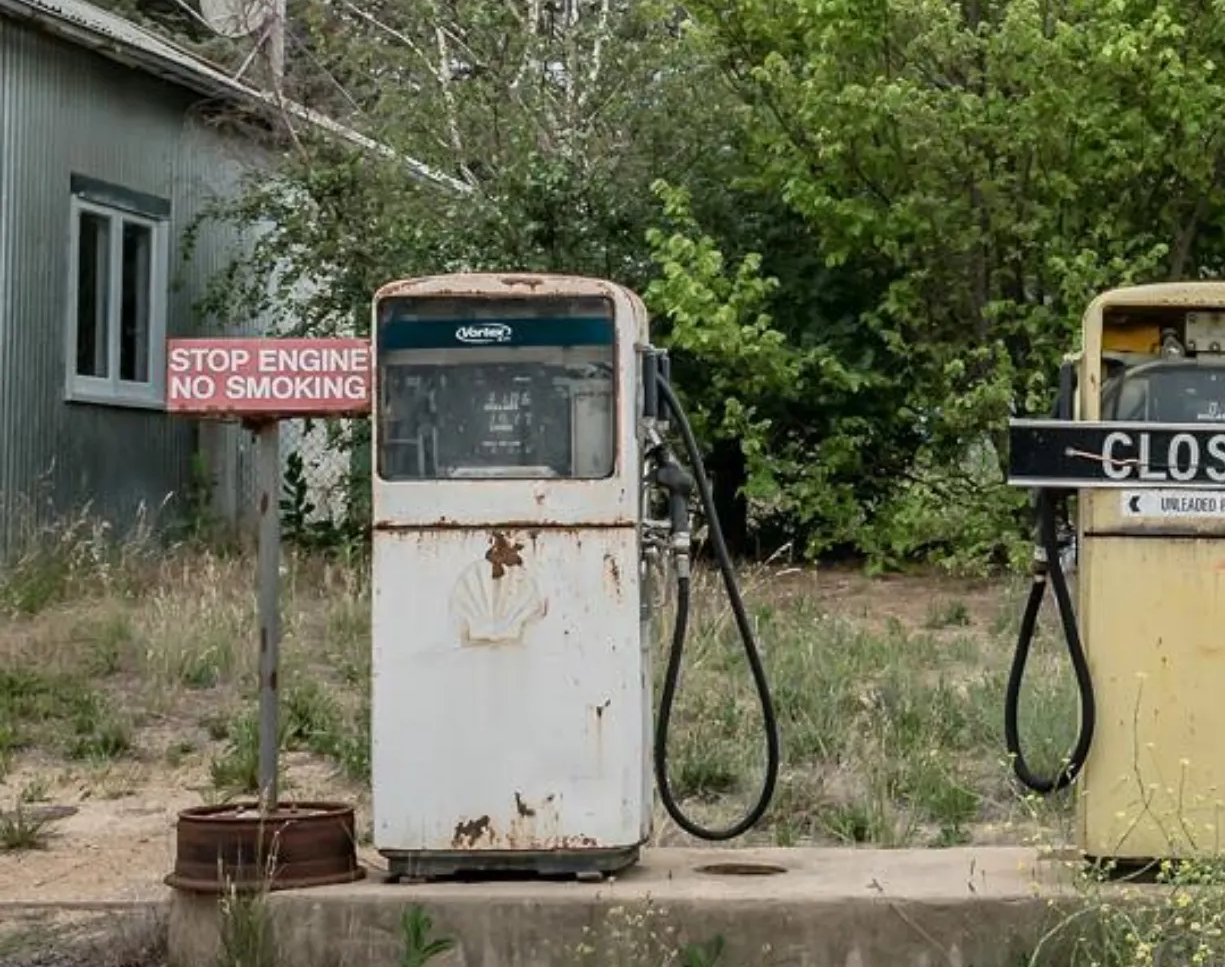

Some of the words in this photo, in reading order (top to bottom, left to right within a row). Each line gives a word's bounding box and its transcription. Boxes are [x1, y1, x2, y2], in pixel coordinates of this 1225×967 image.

[169, 348, 250, 372] STOP
[258, 349, 368, 372] ENGINE
[170, 376, 215, 399] NO
[225, 375, 367, 400] SMOKING
[1160, 496, 1217, 513] UNLEADED
